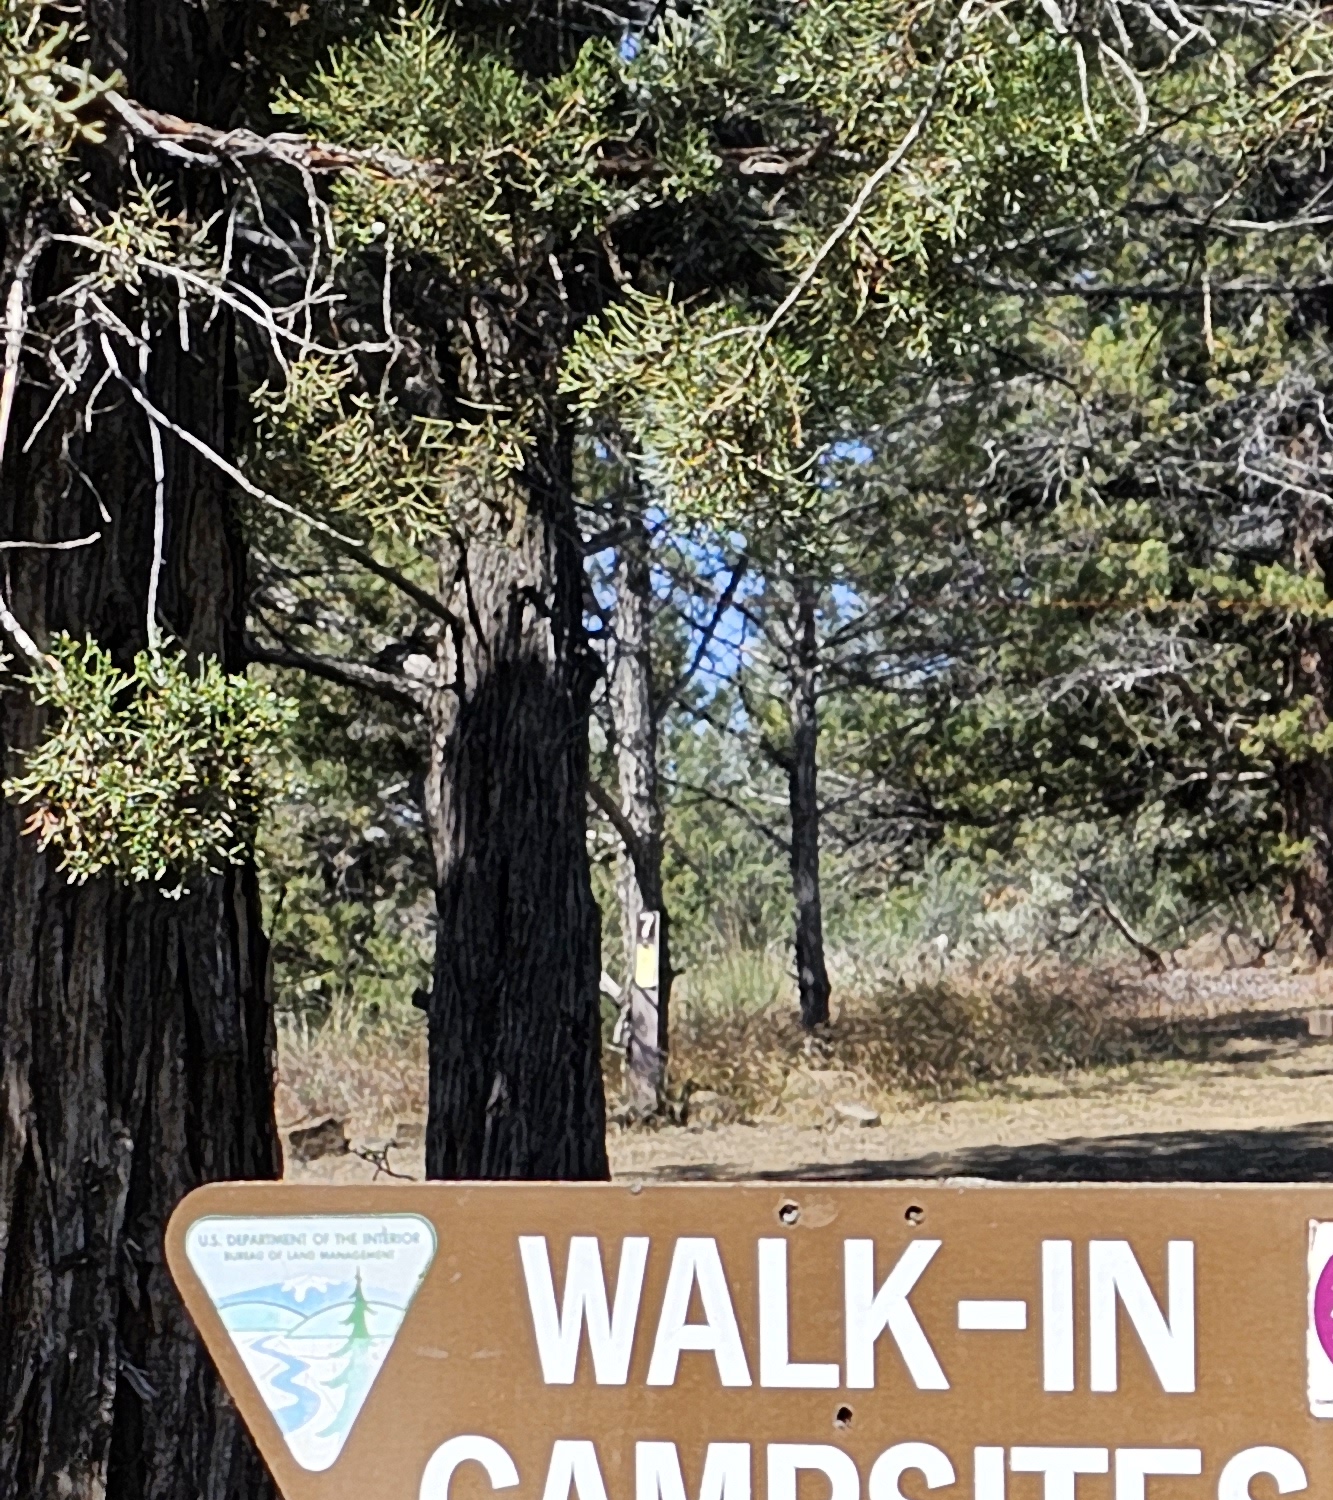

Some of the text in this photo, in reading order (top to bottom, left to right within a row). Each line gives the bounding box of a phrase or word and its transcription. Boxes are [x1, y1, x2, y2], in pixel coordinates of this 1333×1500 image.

[640, 912, 654, 938] 7
[198, 1234, 222, 1247] U.S.
[312, 1232, 330, 1245] OF
[518, 1235, 1195, 1393] WALK-IN
